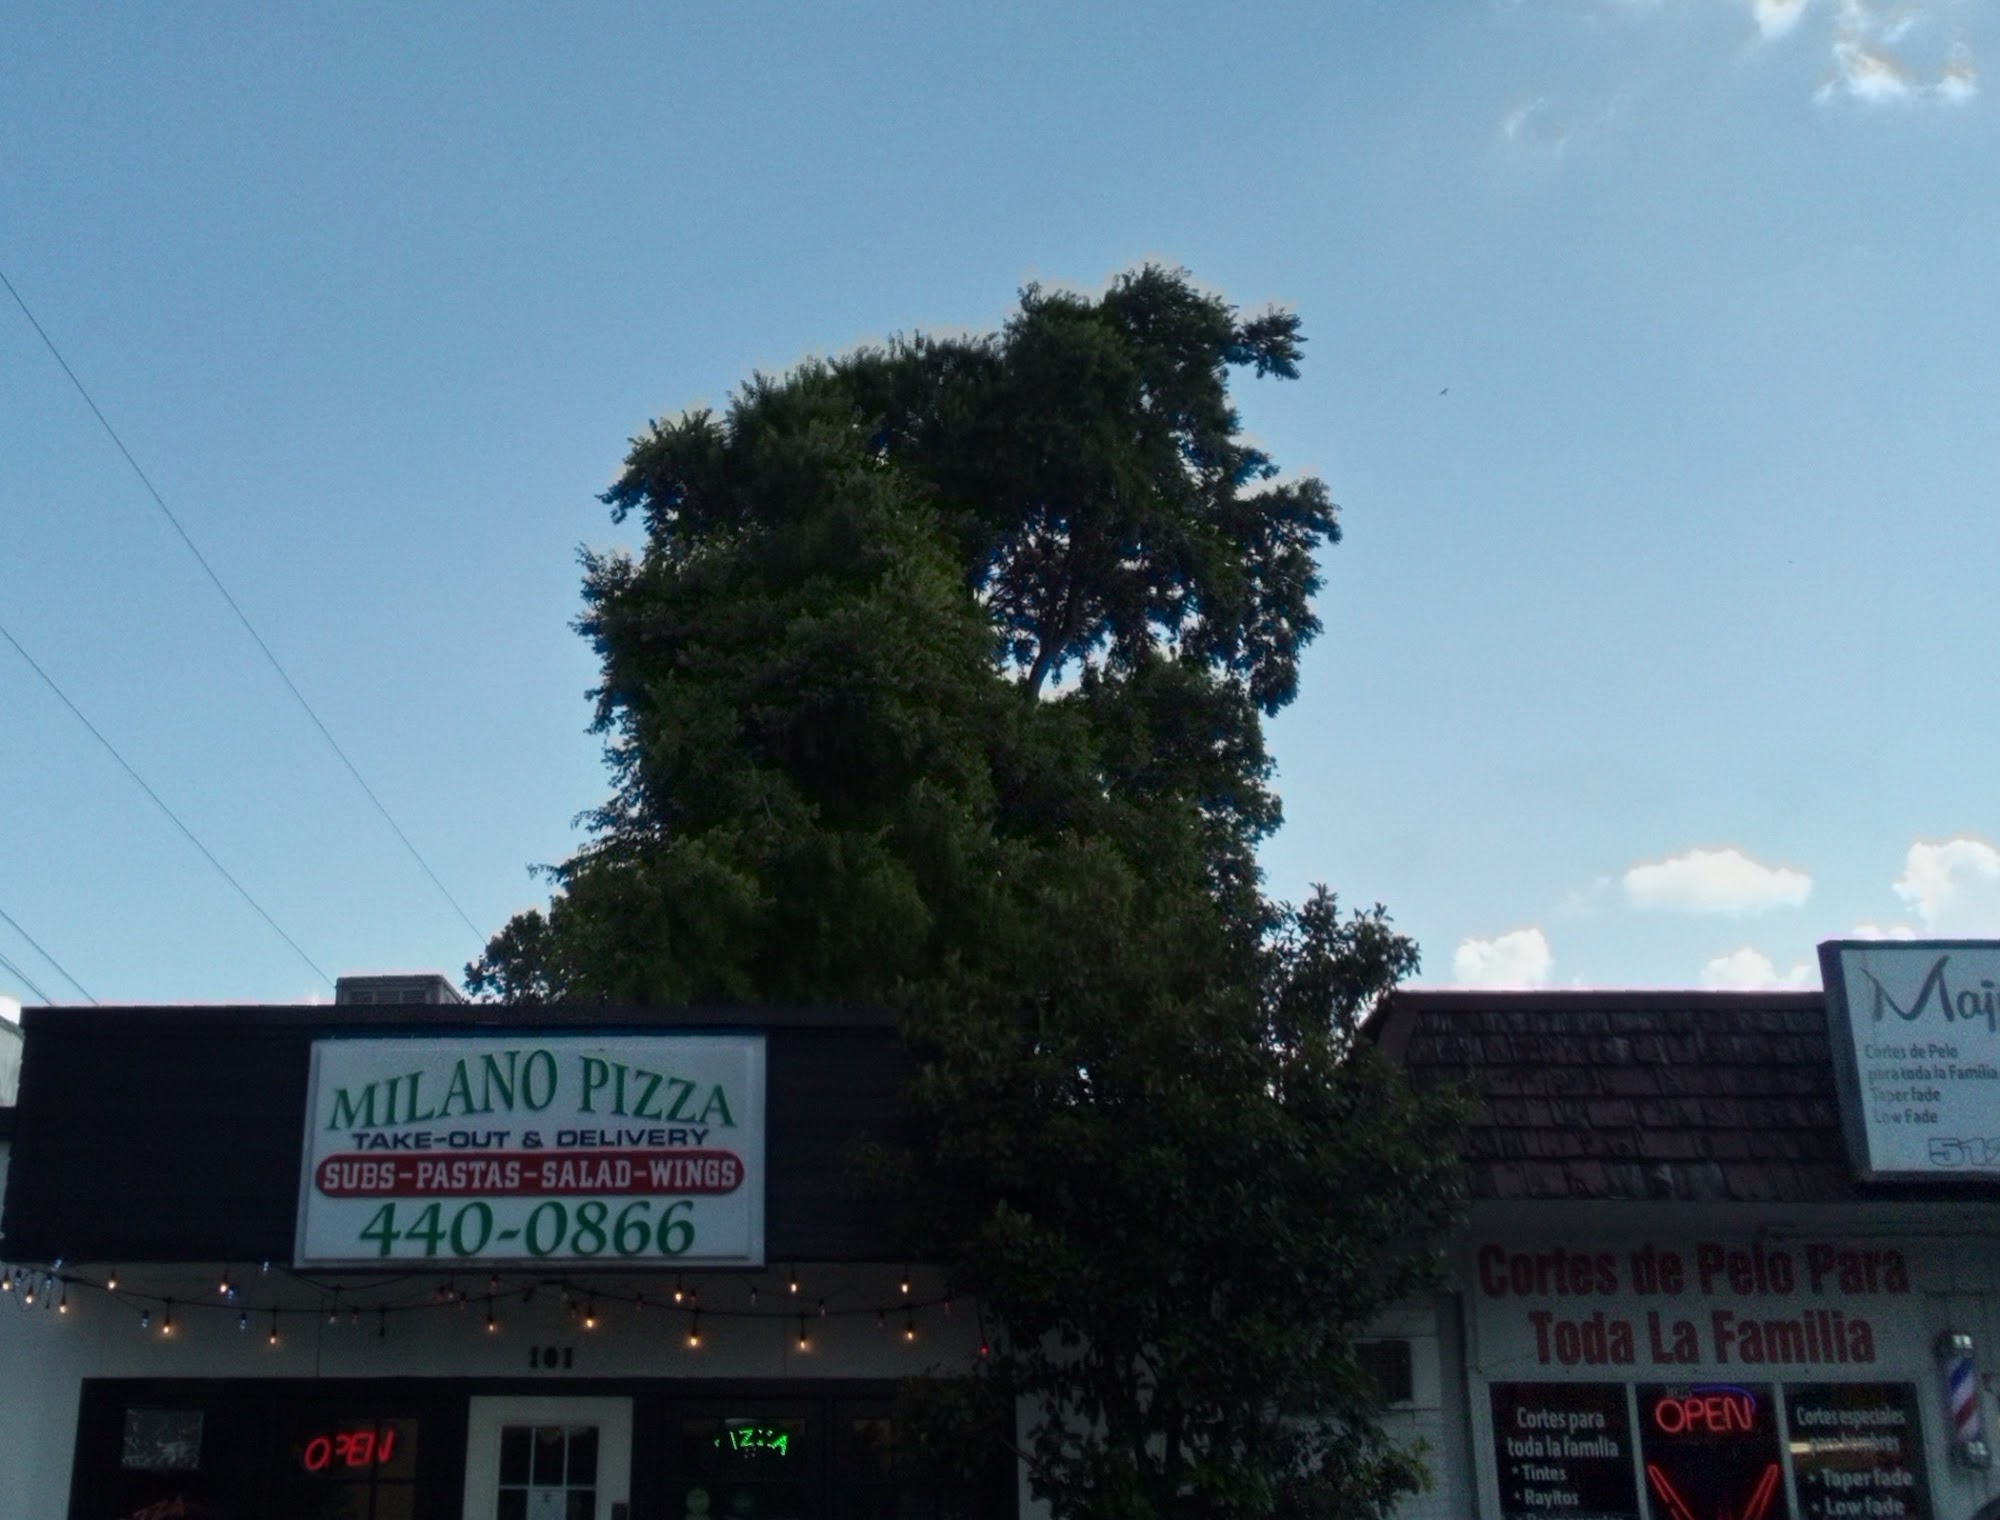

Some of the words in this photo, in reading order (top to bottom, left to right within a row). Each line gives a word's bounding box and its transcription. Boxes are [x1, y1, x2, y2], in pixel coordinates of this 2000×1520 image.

[1861, 954, 2000, 1032] Maj
[1864, 1043, 1906, 1059] Cortes
[1909, 1042, 1926, 1059] de
[1928, 1043, 1958, 1059] Pelo
[1901, 1065, 1931, 1080] toda
[1933, 1064, 1946, 1080] la
[1949, 1064, 1998, 1080] Familia
[325, 1049, 558, 1130] MILANO
[577, 1055, 738, 1128] PIZZA
[352, 1131, 510, 1150] TAKE-OUT
[523, 1131, 543, 1148] &
[557, 1129, 709, 1147] DELIVERY
[359, 1201, 696, 1257] 440-0866
[1479, 1243, 1617, 1298] Cortes
[1631, 1244, 1684, 1294] de
[1699, 1243, 1796, 1296] Pelo
[1806, 1244, 1911, 1295] Para
[1529, 1310, 1635, 1365] Toda
[1648, 1311, 1698, 1364] La
[1713, 1310, 1876, 1364] Familia
[529, 1347, 574, 1369] 101
[1517, 1407, 1566, 1428] Cortes
[1569, 1412, 1605, 1434] para
[1655, 1396, 1753, 1433] OPEN
[1797, 1406, 1838, 1426] Cortes
[1507, 1436, 1544, 1456] toda
[1546, 1435, 1561, 1456] la
[1563, 1435, 1619, 1457] familia
[1521, 1465, 1567, 1480] Tintes
[1821, 1468, 1872, 1493] Taper
[1524, 1489, 1580, 1510] Rayitos
[1825, 1496, 1862, 1516] Low
